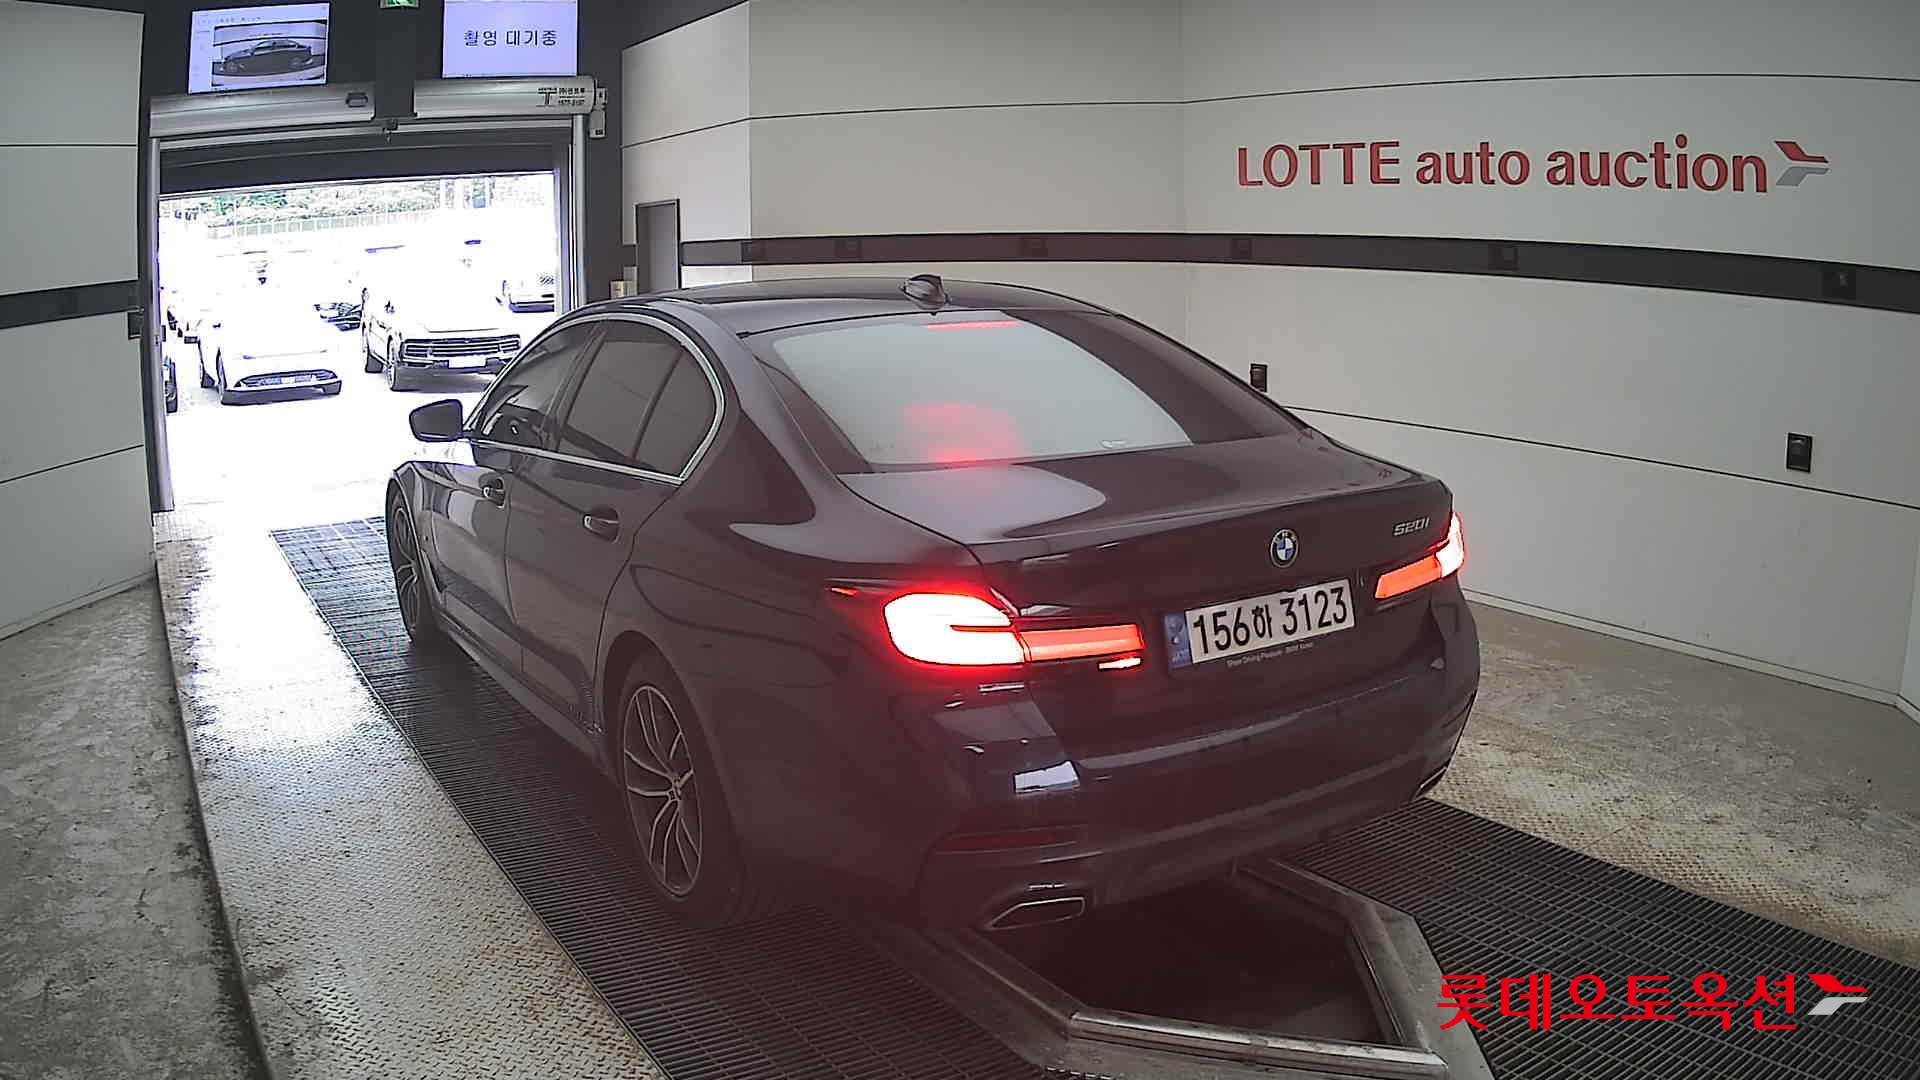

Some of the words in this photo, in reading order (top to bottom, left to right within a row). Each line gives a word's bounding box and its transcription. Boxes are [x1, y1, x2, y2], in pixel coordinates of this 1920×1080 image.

[464, 30, 497, 46] 촬영
[506, 30, 557, 46] 대기중
[1238, 141, 1400, 187] LOTTE
[1416, 142, 1530, 185] auto
[1546, 134, 1767, 193] auction
[1394, 517, 1430, 536] 520i
[1193, 604, 1273, 654] 156하
[1279, 586, 1348, 636] 3123
